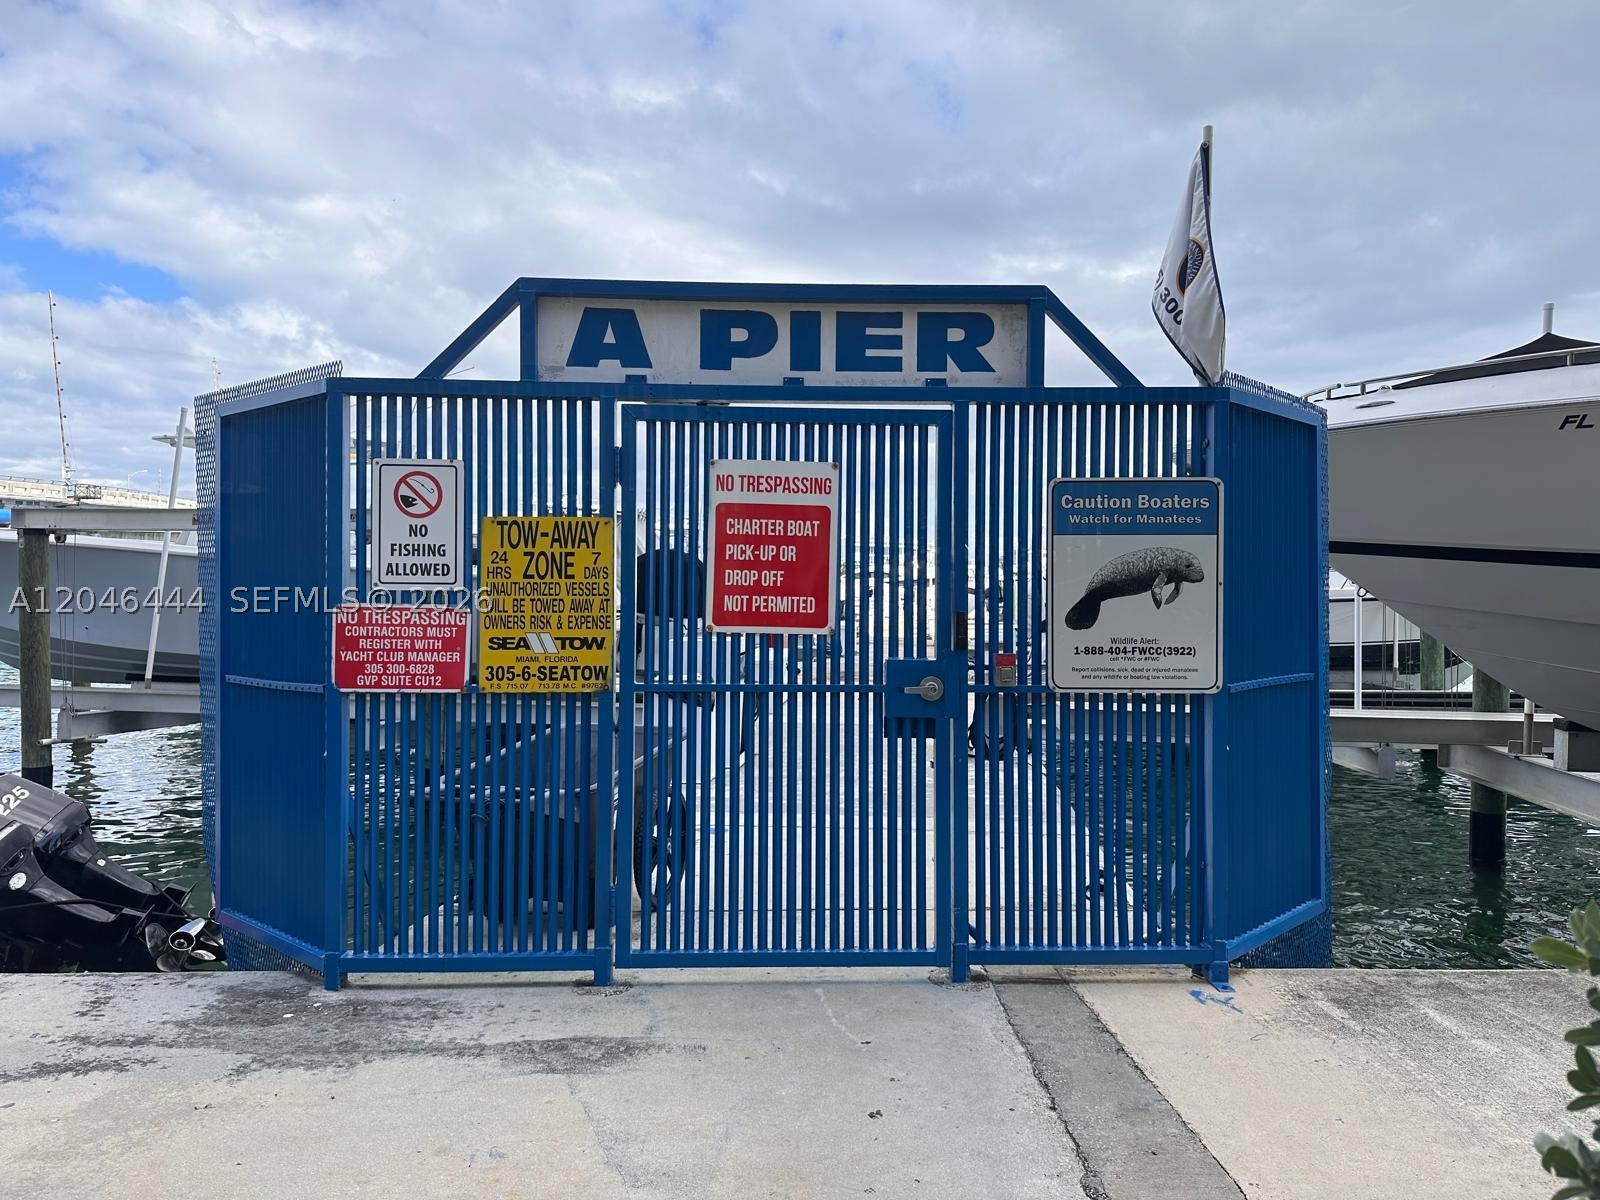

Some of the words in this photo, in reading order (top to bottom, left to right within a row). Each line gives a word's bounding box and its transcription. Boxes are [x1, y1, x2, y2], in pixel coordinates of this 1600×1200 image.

[566, 307, 653, 368] A
[700, 309, 997, 373] PIER
[1559, 414, 1594, 430] FL
[715, 474, 735, 492] NO
[738, 475, 832, 495] TRESPASSING
[1061, 494, 1131, 509] Caution
[1138, 494, 1210, 509] Boaters
[1069, 514, 1110, 524] Watch
[1113, 514, 1132, 524] for
[1136, 514, 1202, 524] Manatees
[408, 524, 428, 537] NO
[496, 519, 600, 549] TOW-AWAY
[726, 518, 784, 536] CHARTER
[787, 520, 820, 537] BOAT
[390, 543, 446, 557] FISHING
[725, 544, 777, 562] PICK-UP
[779, 545, 797, 562] OR
[385, 562, 451, 577] ALLOWED
[490, 551, 508, 564] 24
[522, 551, 575, 580] ZONE
[591, 552, 602, 565] 7
[486, 567, 512, 579] HRS
[583, 567, 609, 580] DAYS
[724, 570, 758, 586] DROP
[761, 571, 785, 587] OFF
[486, 581, 561, 597] UNAUTHORIZED
[565, 581, 610, 597] VESSELS
[485, 598, 509, 614] WILL
[512, 598, 526, 613] BE
[530, 598, 566, 613] TOWED
[569, 598, 595, 613] AWAY
[598, 598, 611, 613] AT
[723, 595, 750, 612] NOT
[751, 596, 816, 614] PERMITED
[337, 609, 359, 624] NO
[362, 609, 467, 626] TRESPASSING
[483, 614, 526, 630] OWNERS
[529, 615, 553, 630] RISK
[556, 615, 563, 630] &
[567, 615, 612, 630] EXPENSE
[345, 626, 424, 637] CONTRACTORS
[426, 627, 458, 638] MUST
[359, 638, 412, 650] REGISTER
[414, 639, 442, 650] WITH
[487, 636, 532, 651] SEA
[553, 636, 607, 651] TOW
[1110, 637, 1138, 645] Wildlife
[1139, 637, 1159, 645] Alert:
[340, 651, 374, 662] YACHT
[376, 651, 404, 662] CLUB
[407, 652, 460, 663] MANAGER
[1073, 646, 1196, 658] 1-888-404-FWCC(3922)
[364, 664, 383, 674] 305
[386, 665, 435, 675] 300-6828
[485, 665, 609, 682] 305-6-SEATOW
[357, 676, 379, 686] GVP
[381, 676, 412, 686] SUITE
[415, 676, 442, 687] CU12
